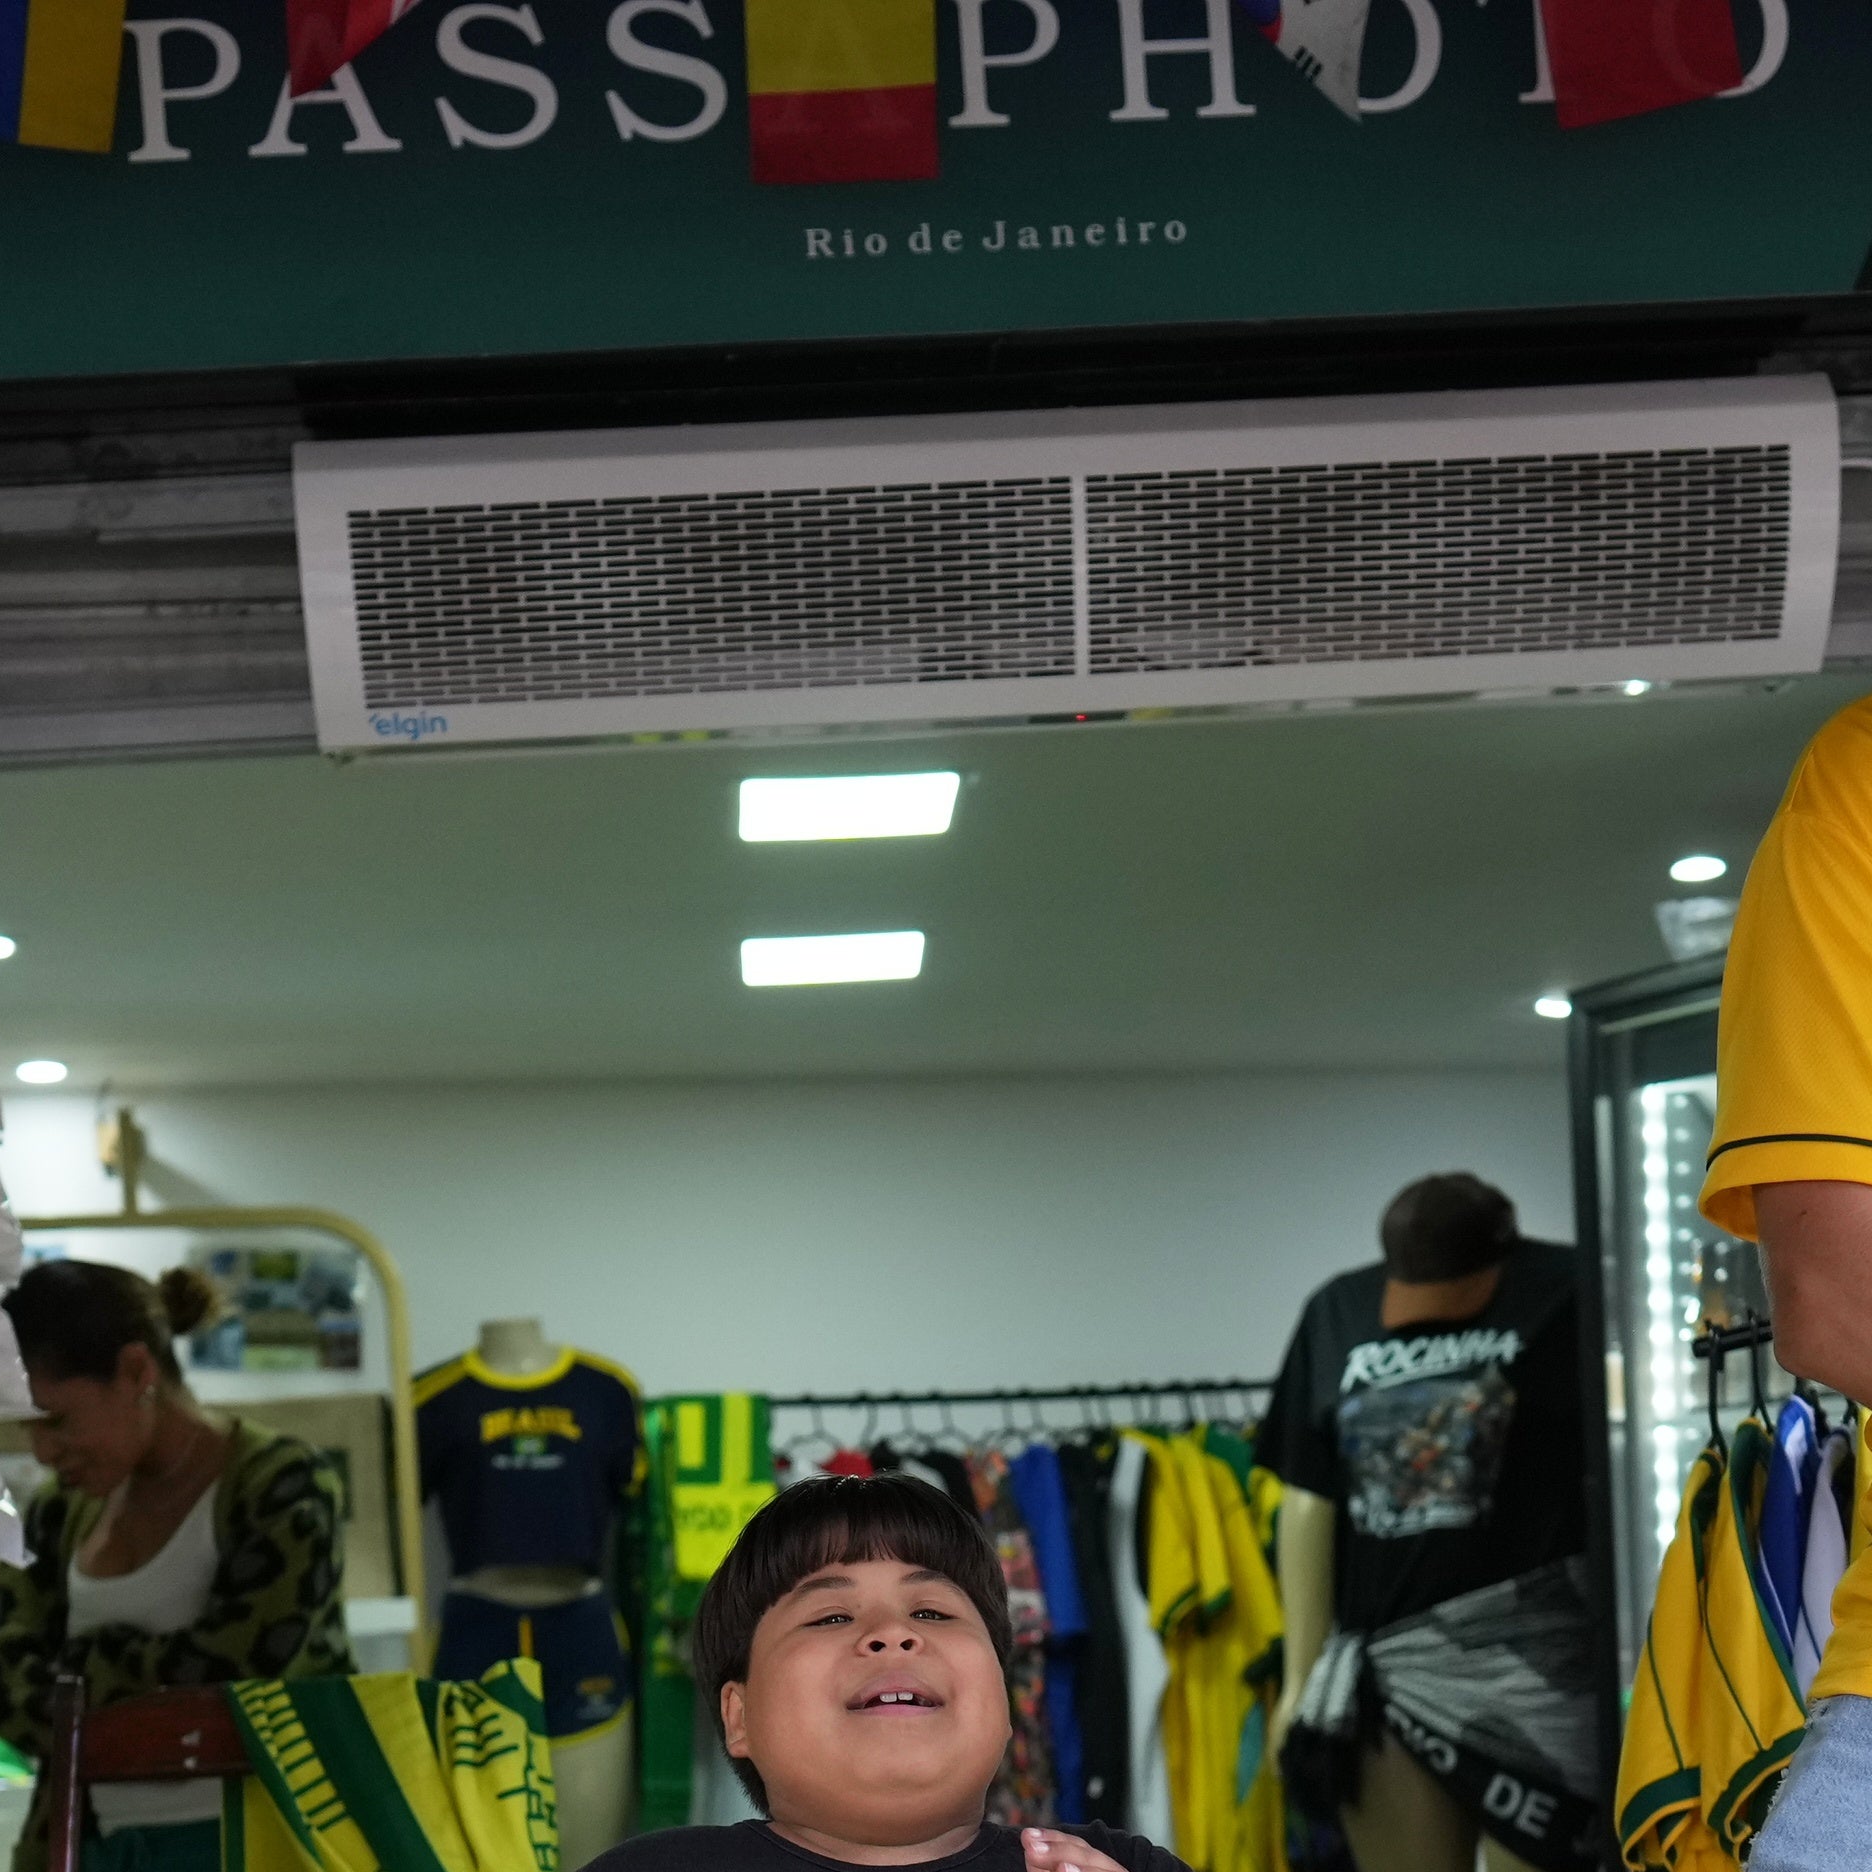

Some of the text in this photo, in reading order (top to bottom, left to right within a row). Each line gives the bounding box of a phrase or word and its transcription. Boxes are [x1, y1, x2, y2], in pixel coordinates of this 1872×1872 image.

[804, 216, 1188, 259] Rio de Janeiro
[371, 711, 449, 741] elgin
[1483, 1773, 1559, 1841] DE
